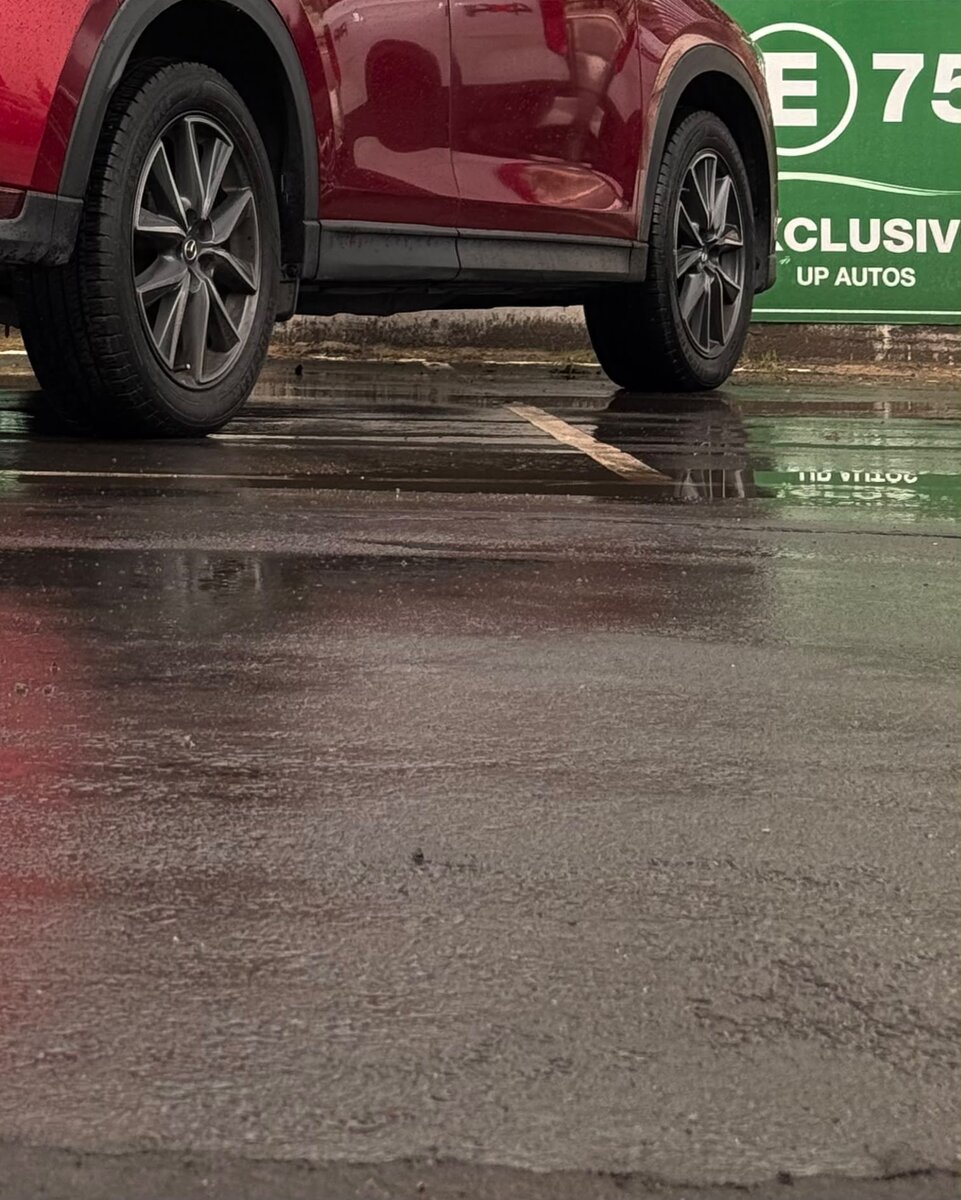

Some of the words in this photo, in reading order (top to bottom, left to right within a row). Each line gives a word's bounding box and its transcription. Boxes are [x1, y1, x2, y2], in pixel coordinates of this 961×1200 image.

[762, 52, 817, 127] E
[775, 217, 961, 253] CLUSIV
[797, 267, 829, 287] UP
[834, 266, 916, 287] AUTOS
